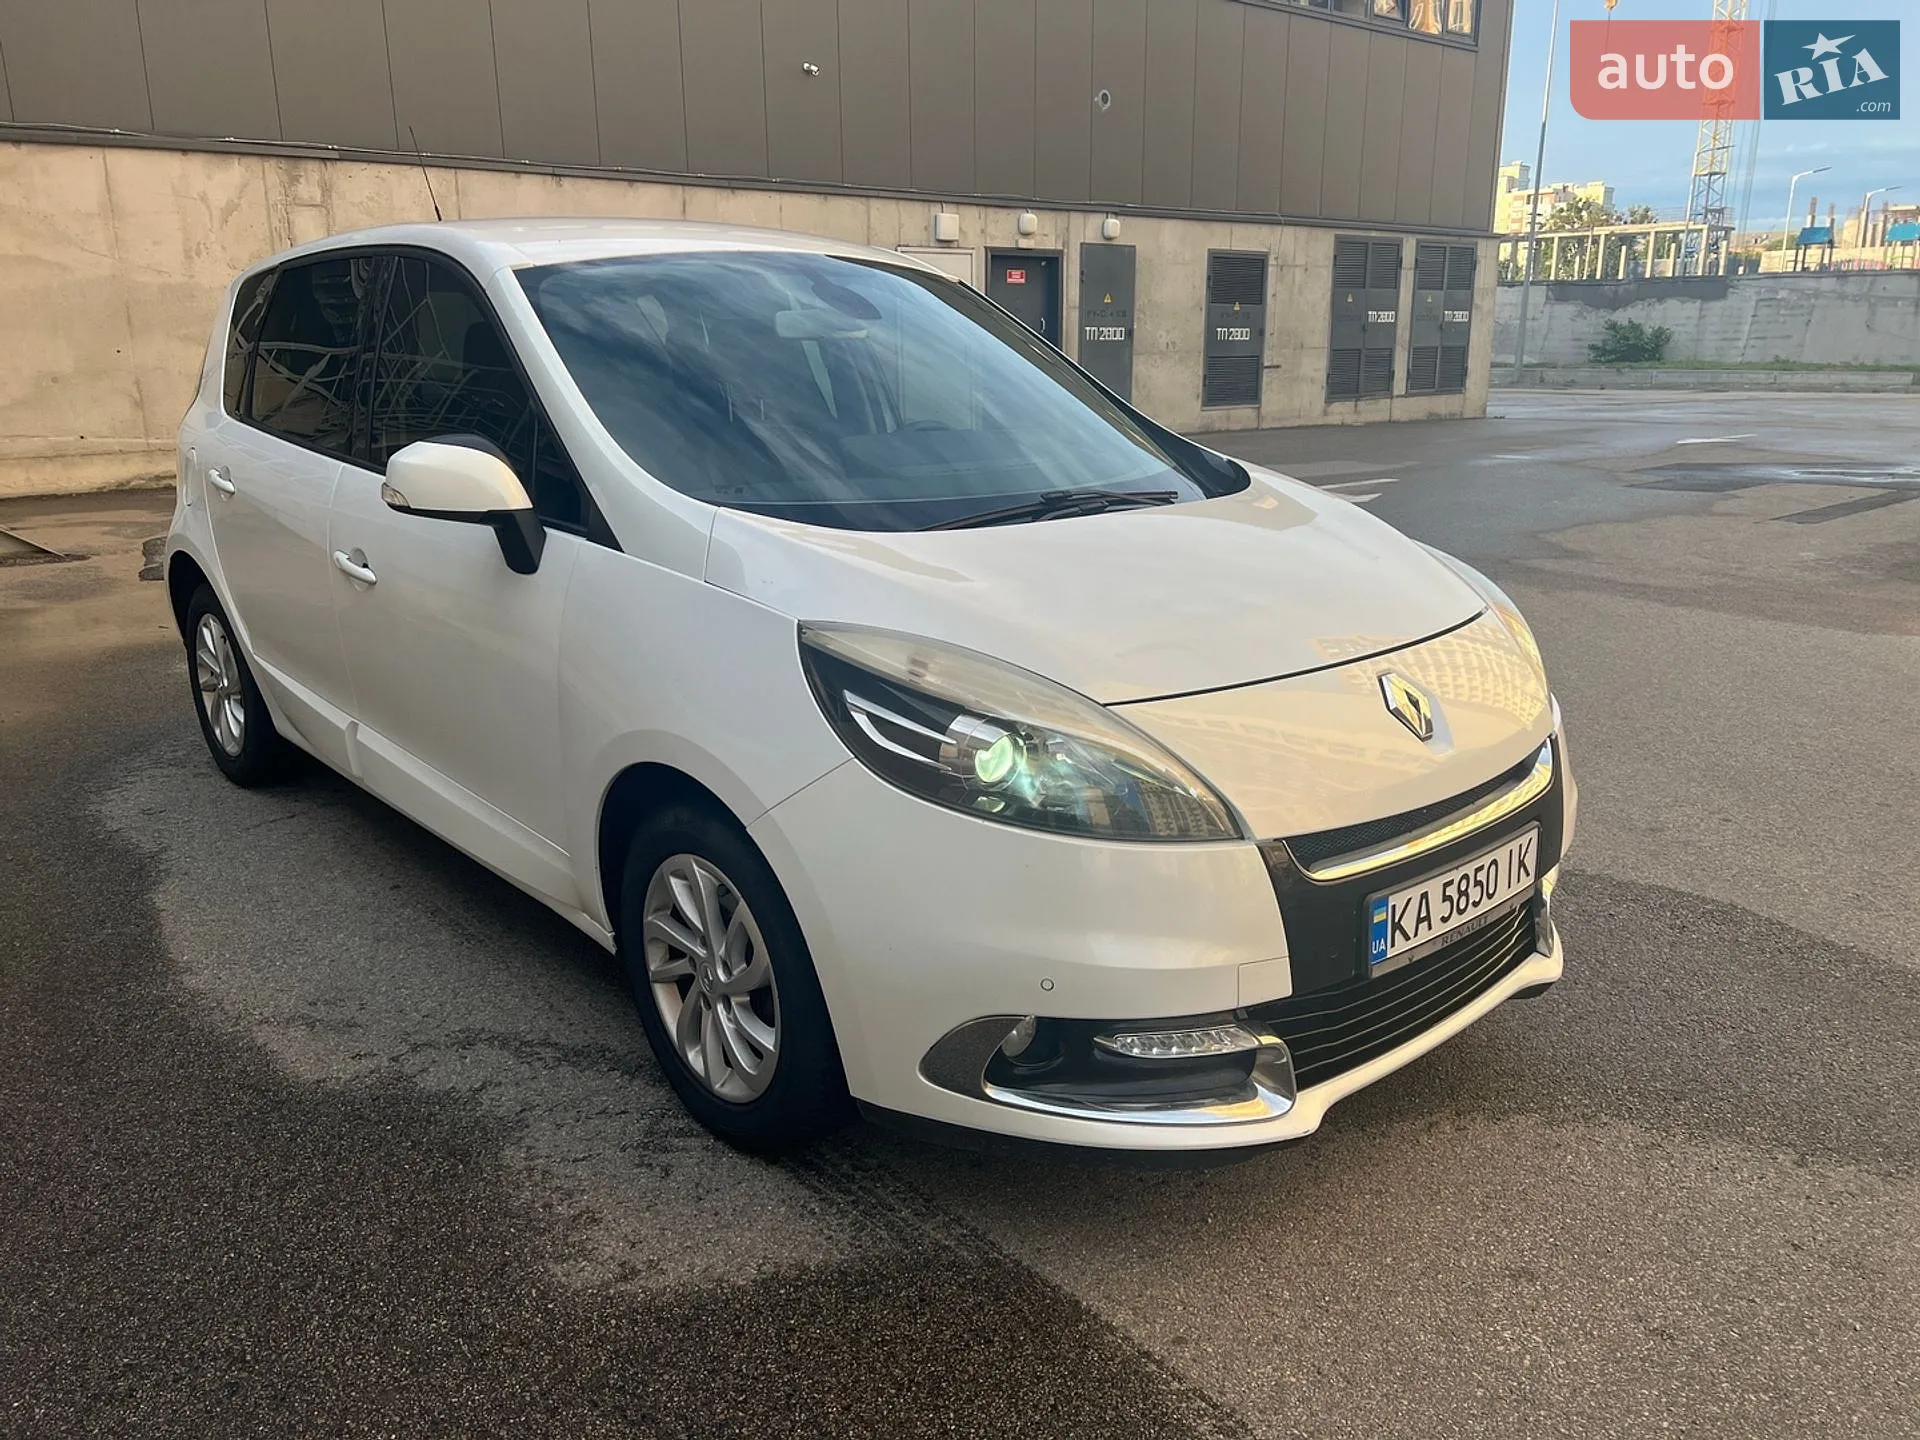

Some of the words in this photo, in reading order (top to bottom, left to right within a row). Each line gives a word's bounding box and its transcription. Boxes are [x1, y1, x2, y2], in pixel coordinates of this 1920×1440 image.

[1390, 890, 1433, 949] KA
[1440, 858, 1498, 924] 5850
[1507, 837, 1533, 889] IK
[1372, 941, 1387, 954] UA
